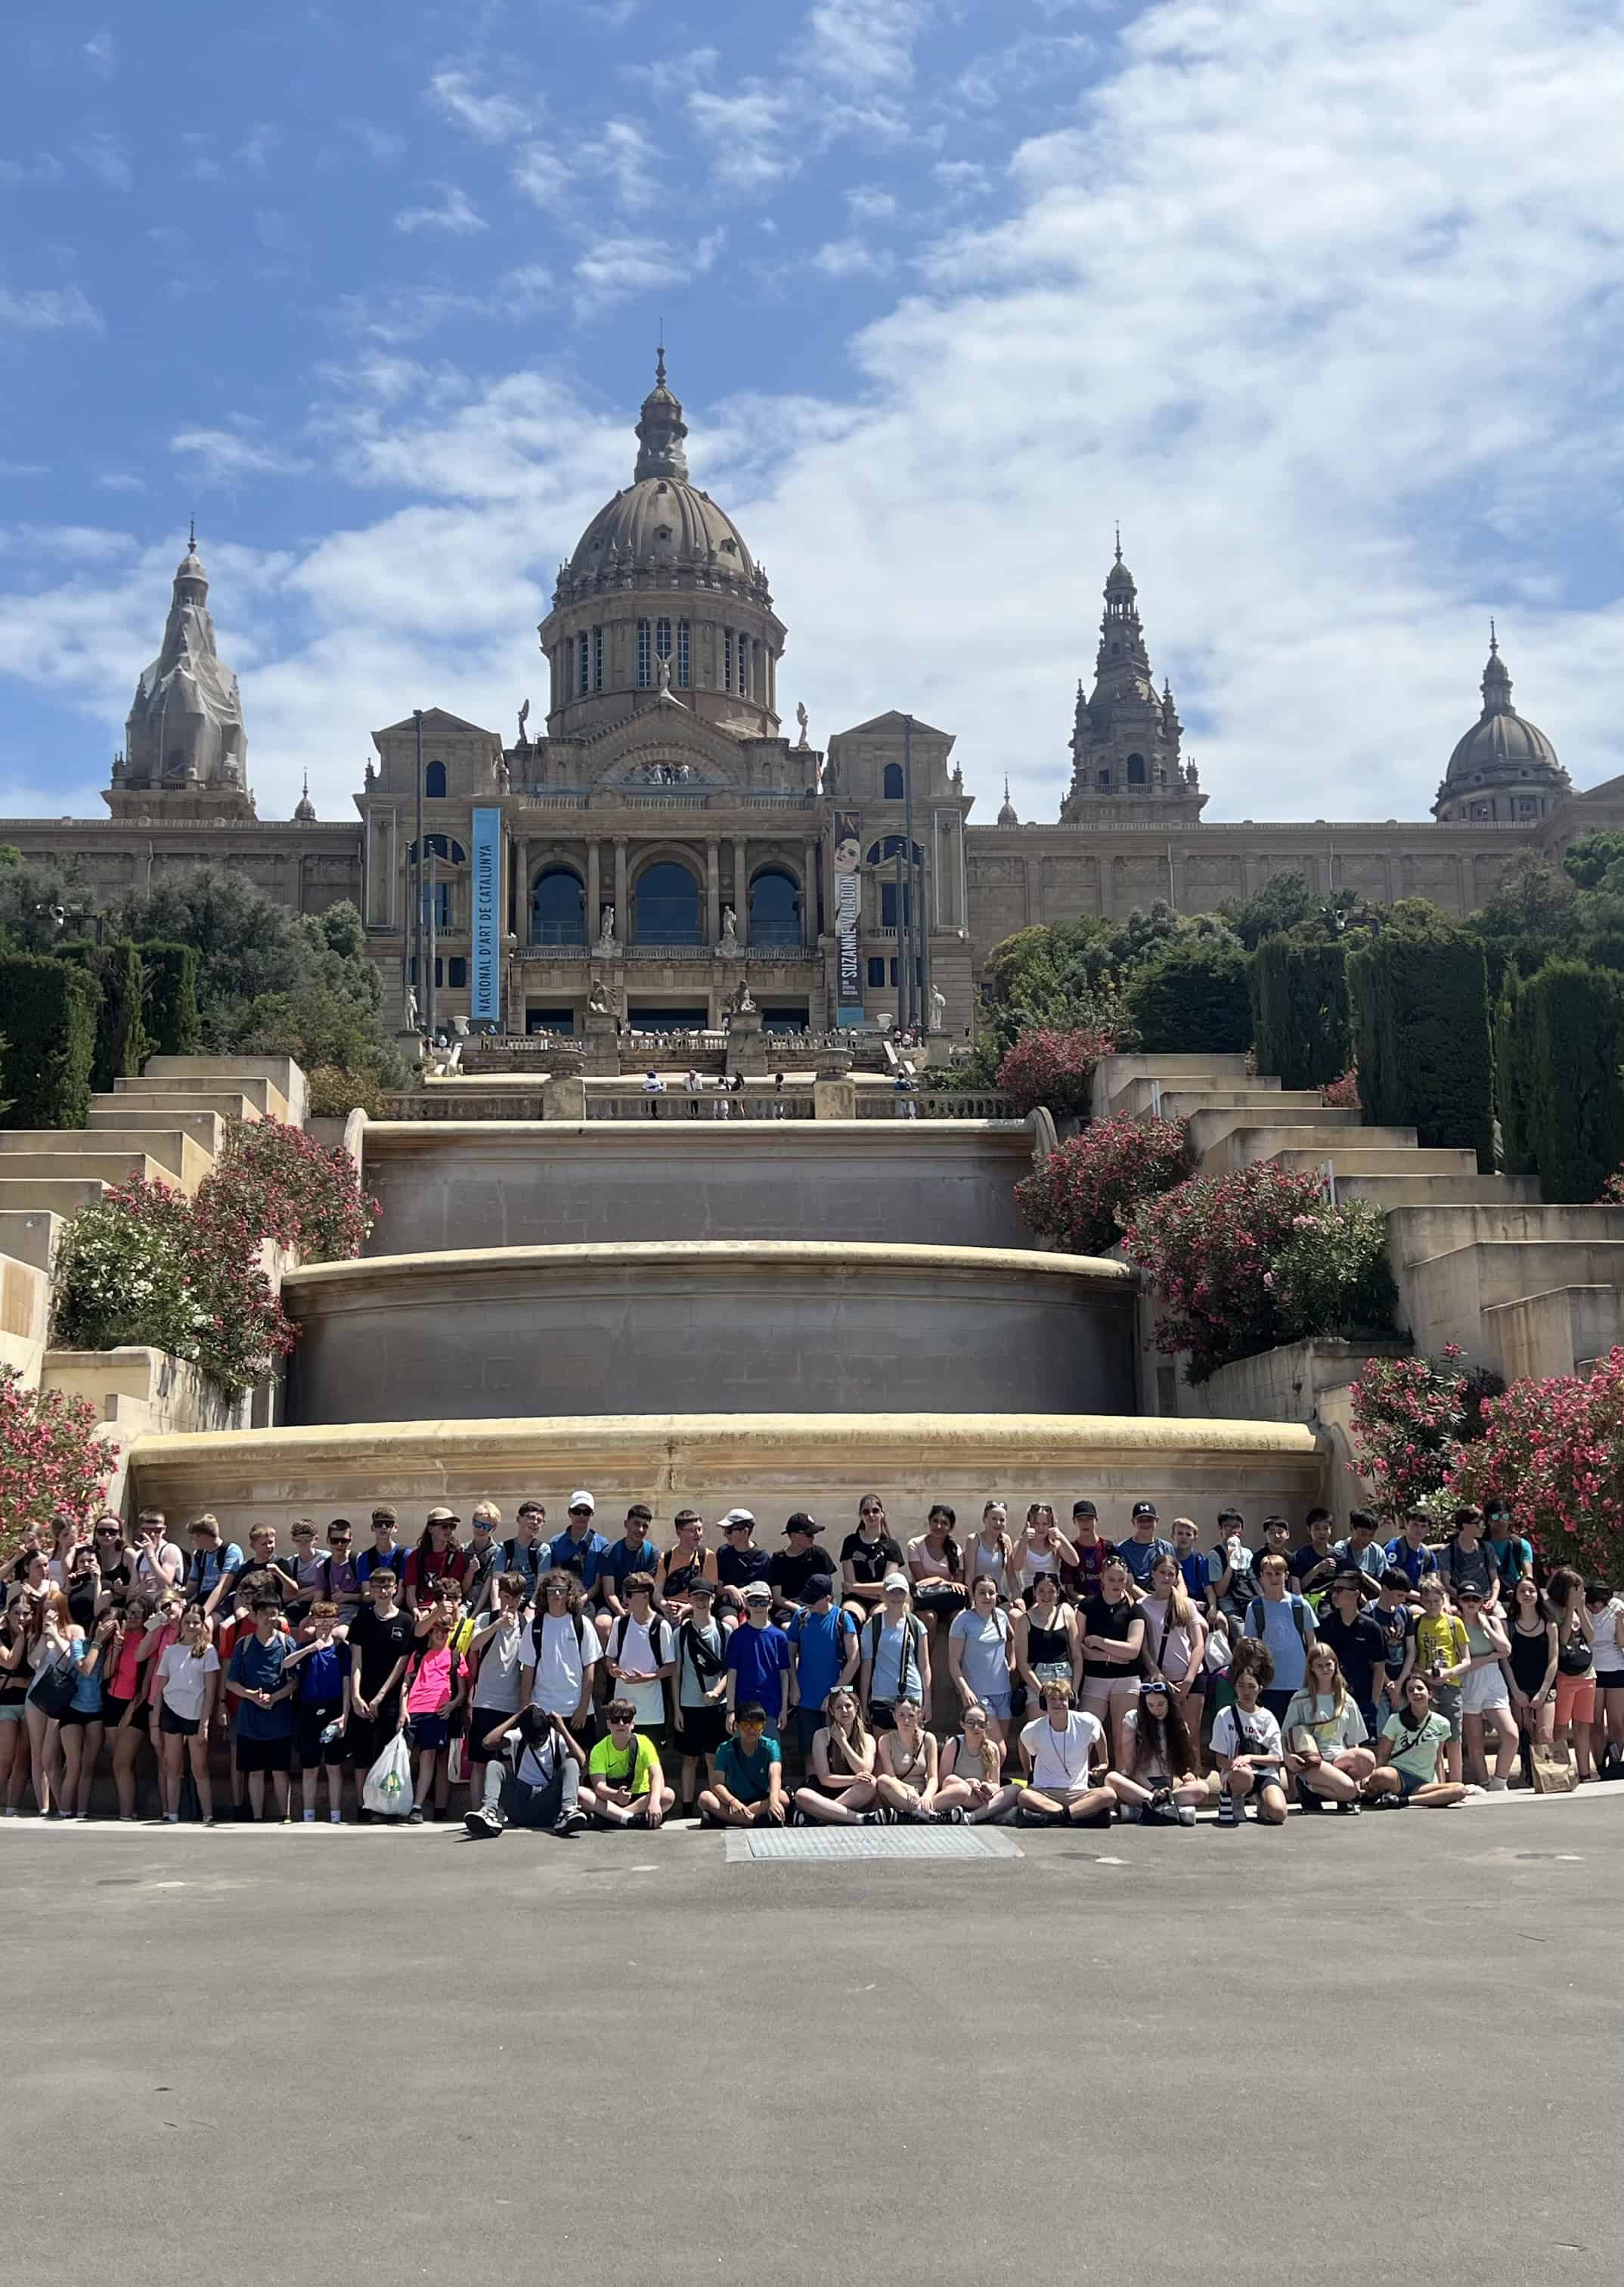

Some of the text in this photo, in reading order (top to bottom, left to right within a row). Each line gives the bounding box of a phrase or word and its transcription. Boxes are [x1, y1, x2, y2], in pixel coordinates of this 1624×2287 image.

[479, 845, 491, 903] CATALUNYA
[479, 908, 491, 920] DE
[840, 875, 856, 925] VALADON
[479, 926, 491, 955] D'ART
[841, 927, 857, 978] SUZANNE
[479, 959, 491, 1012] NACIONAL
